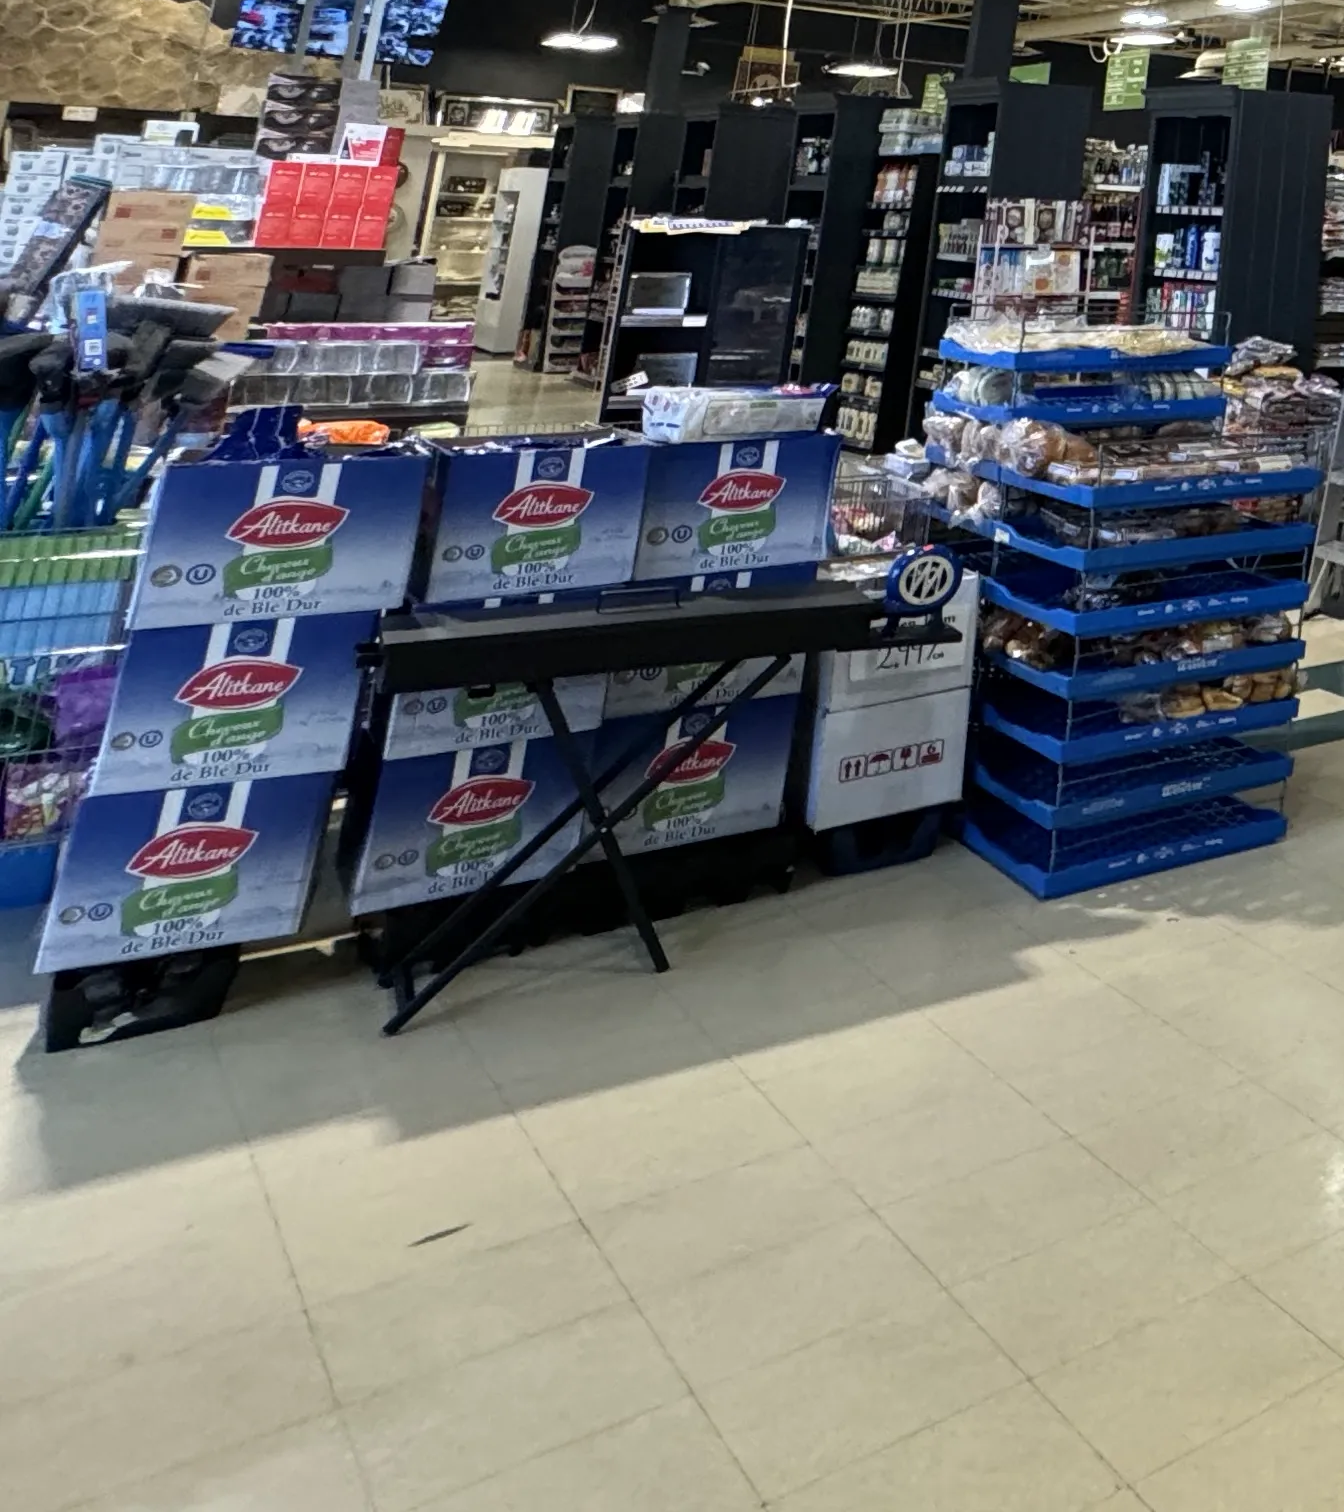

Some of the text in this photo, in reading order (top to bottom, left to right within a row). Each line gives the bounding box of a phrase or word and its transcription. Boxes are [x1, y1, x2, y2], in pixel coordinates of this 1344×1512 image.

[708, 480, 775, 503] Alitkane
[506, 494, 580, 519] Alitkane
[242, 511, 333, 538] Alitkane
[720, 543, 755, 555] 100%
[517, 562, 557, 575] 100%
[700, 558, 716, 569] de
[745, 553, 770, 565] Dur
[493, 580, 512, 590] de
[545, 573, 575, 585] Dur
[253, 585, 300, 599] 100%
[224, 604, 243, 616] de
[287, 598, 323, 611] Dur
[193, 672, 285, 700] Alitkane
[481, 713, 521, 727] 100%
[455, 732, 472, 744] de
[510, 724, 540, 736] Dur
[202, 748, 252, 764] 100%
[170, 770, 194, 783] de
[235, 761, 271, 775] Dur
[443, 790, 522, 818] Alitkane
[666, 816, 702, 829] 100%
[144, 839, 241, 870] Alitkane
[453, 860, 494, 875] 100%
[428, 882, 447, 894] de
[152, 918, 204, 935] 100%
[121, 940, 144, 955] de
[189, 929, 225, 944] Dur
